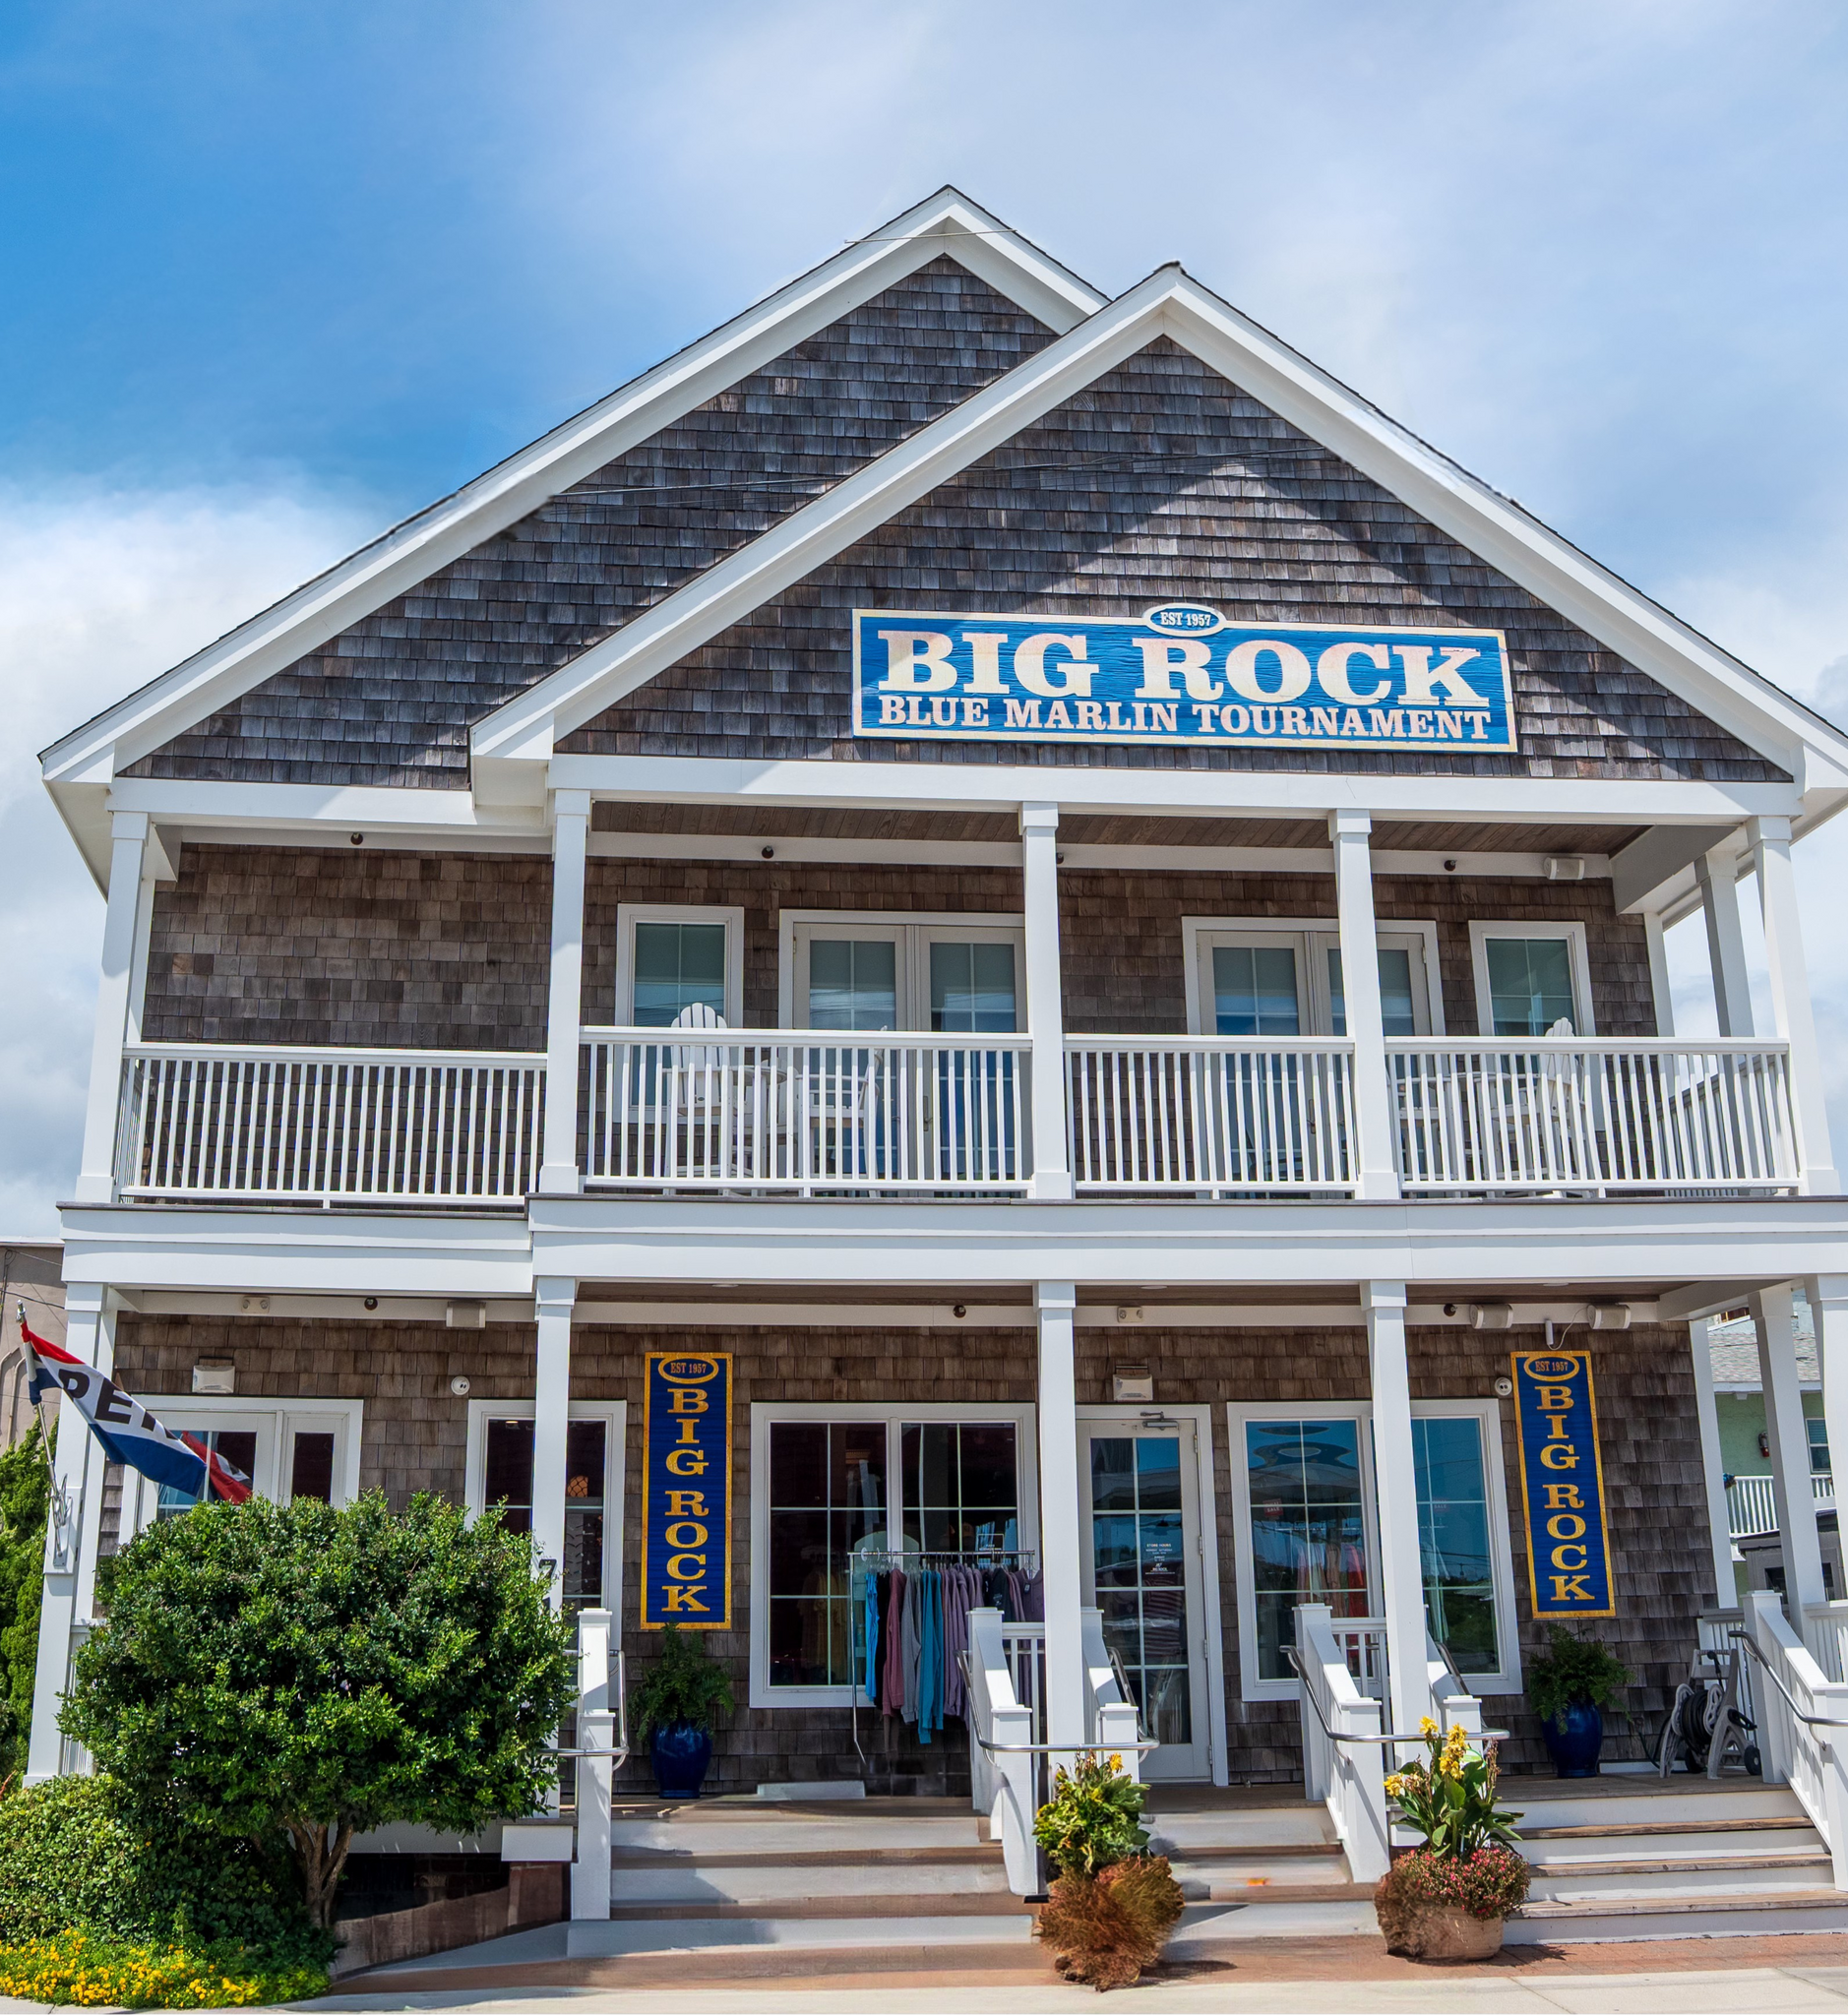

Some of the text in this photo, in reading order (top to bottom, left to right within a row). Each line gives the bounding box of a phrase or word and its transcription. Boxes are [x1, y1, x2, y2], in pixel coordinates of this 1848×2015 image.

[1160, 612, 1211, 627] EST 1957
[878, 630, 1490, 707] BIG ROCK
[878, 695, 1492, 740] BLUE MARLIN TOURNAMENT
[670, 1362, 708, 1374] EST 1957
[1535, 1361, 1569, 1372] EST 1957
[661, 1388, 710, 1612] BIG ROCK
[1534, 1385, 1596, 1602] BIG ROCK
